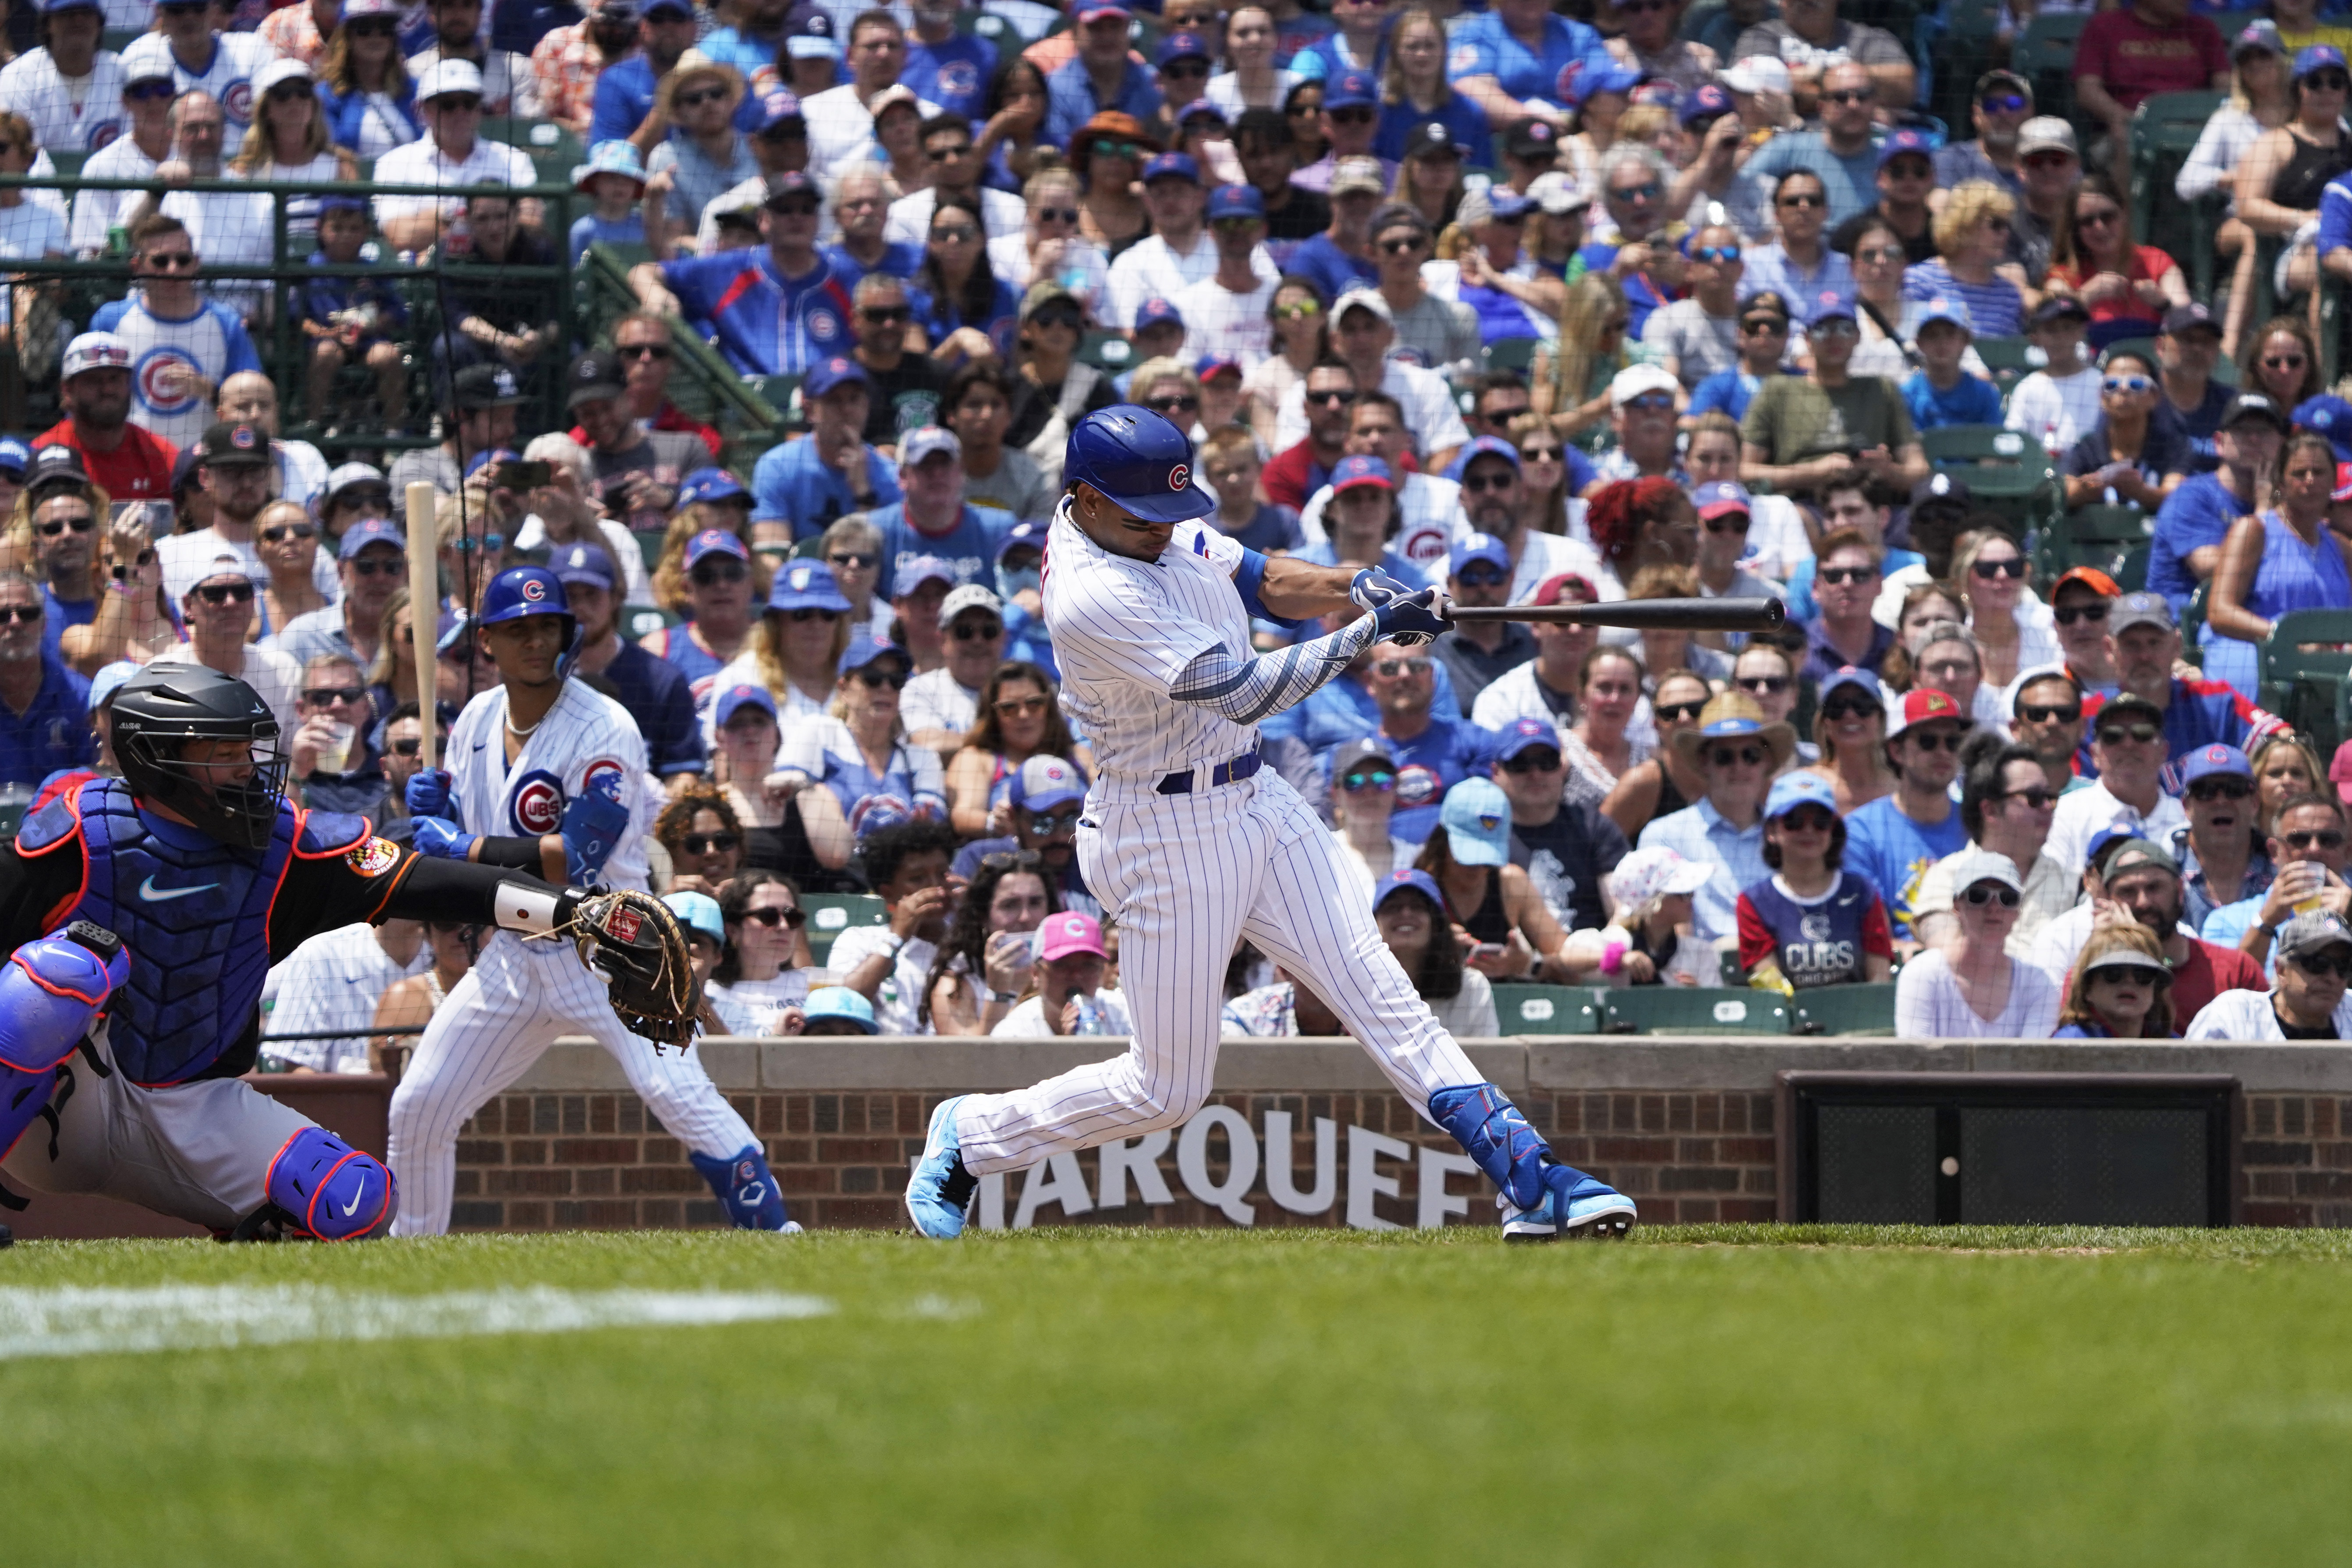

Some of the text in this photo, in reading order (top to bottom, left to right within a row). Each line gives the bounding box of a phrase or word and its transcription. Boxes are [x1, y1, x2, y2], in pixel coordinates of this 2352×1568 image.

[1169, 464, 1187, 491] C
[523, 579, 545, 601] C
[515, 780, 561, 835] CUBS
[374, 848, 400, 876] ORIOLES
[1064, 919, 1086, 937] C
[1786, 940, 1854, 972] CUBS
